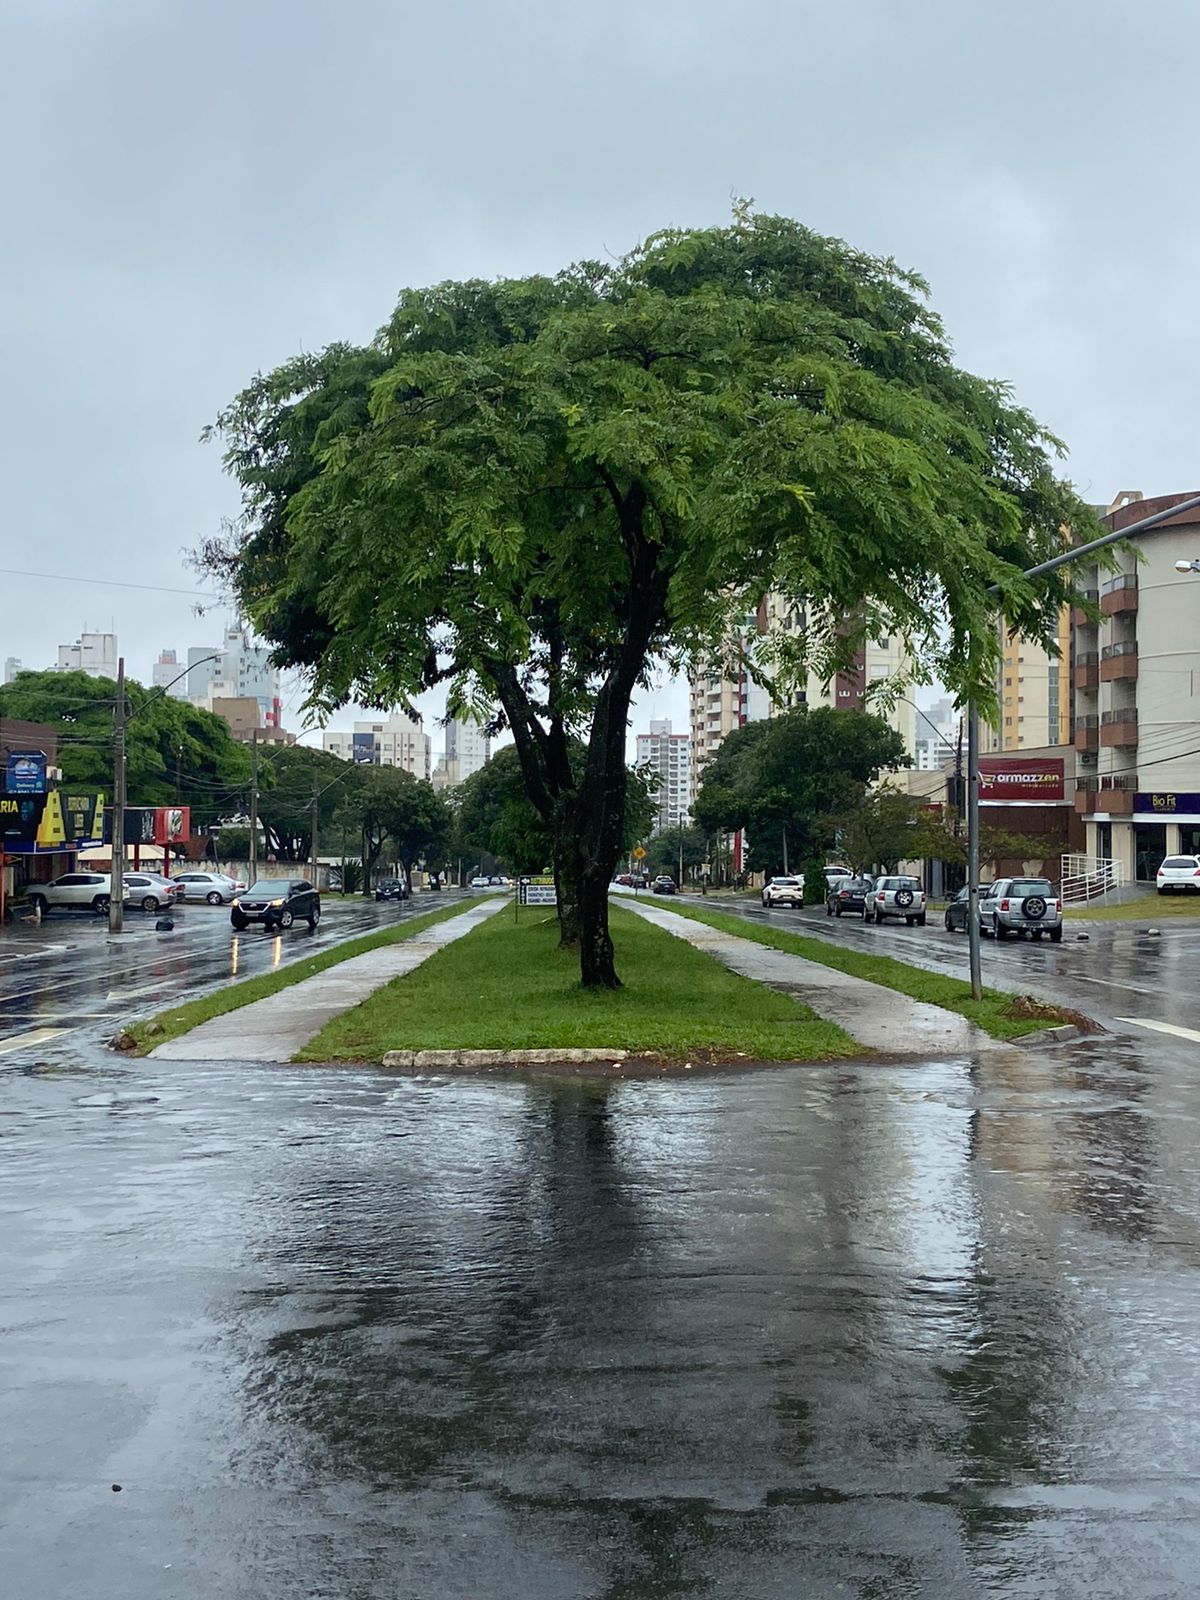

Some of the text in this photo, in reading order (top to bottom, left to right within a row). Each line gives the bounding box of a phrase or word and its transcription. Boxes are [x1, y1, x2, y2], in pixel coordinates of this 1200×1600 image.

[997, 773, 1059, 783] armazzen
[0, 800, 19, 813] RIA
[1152, 794, 1177, 807] Bio Fit
